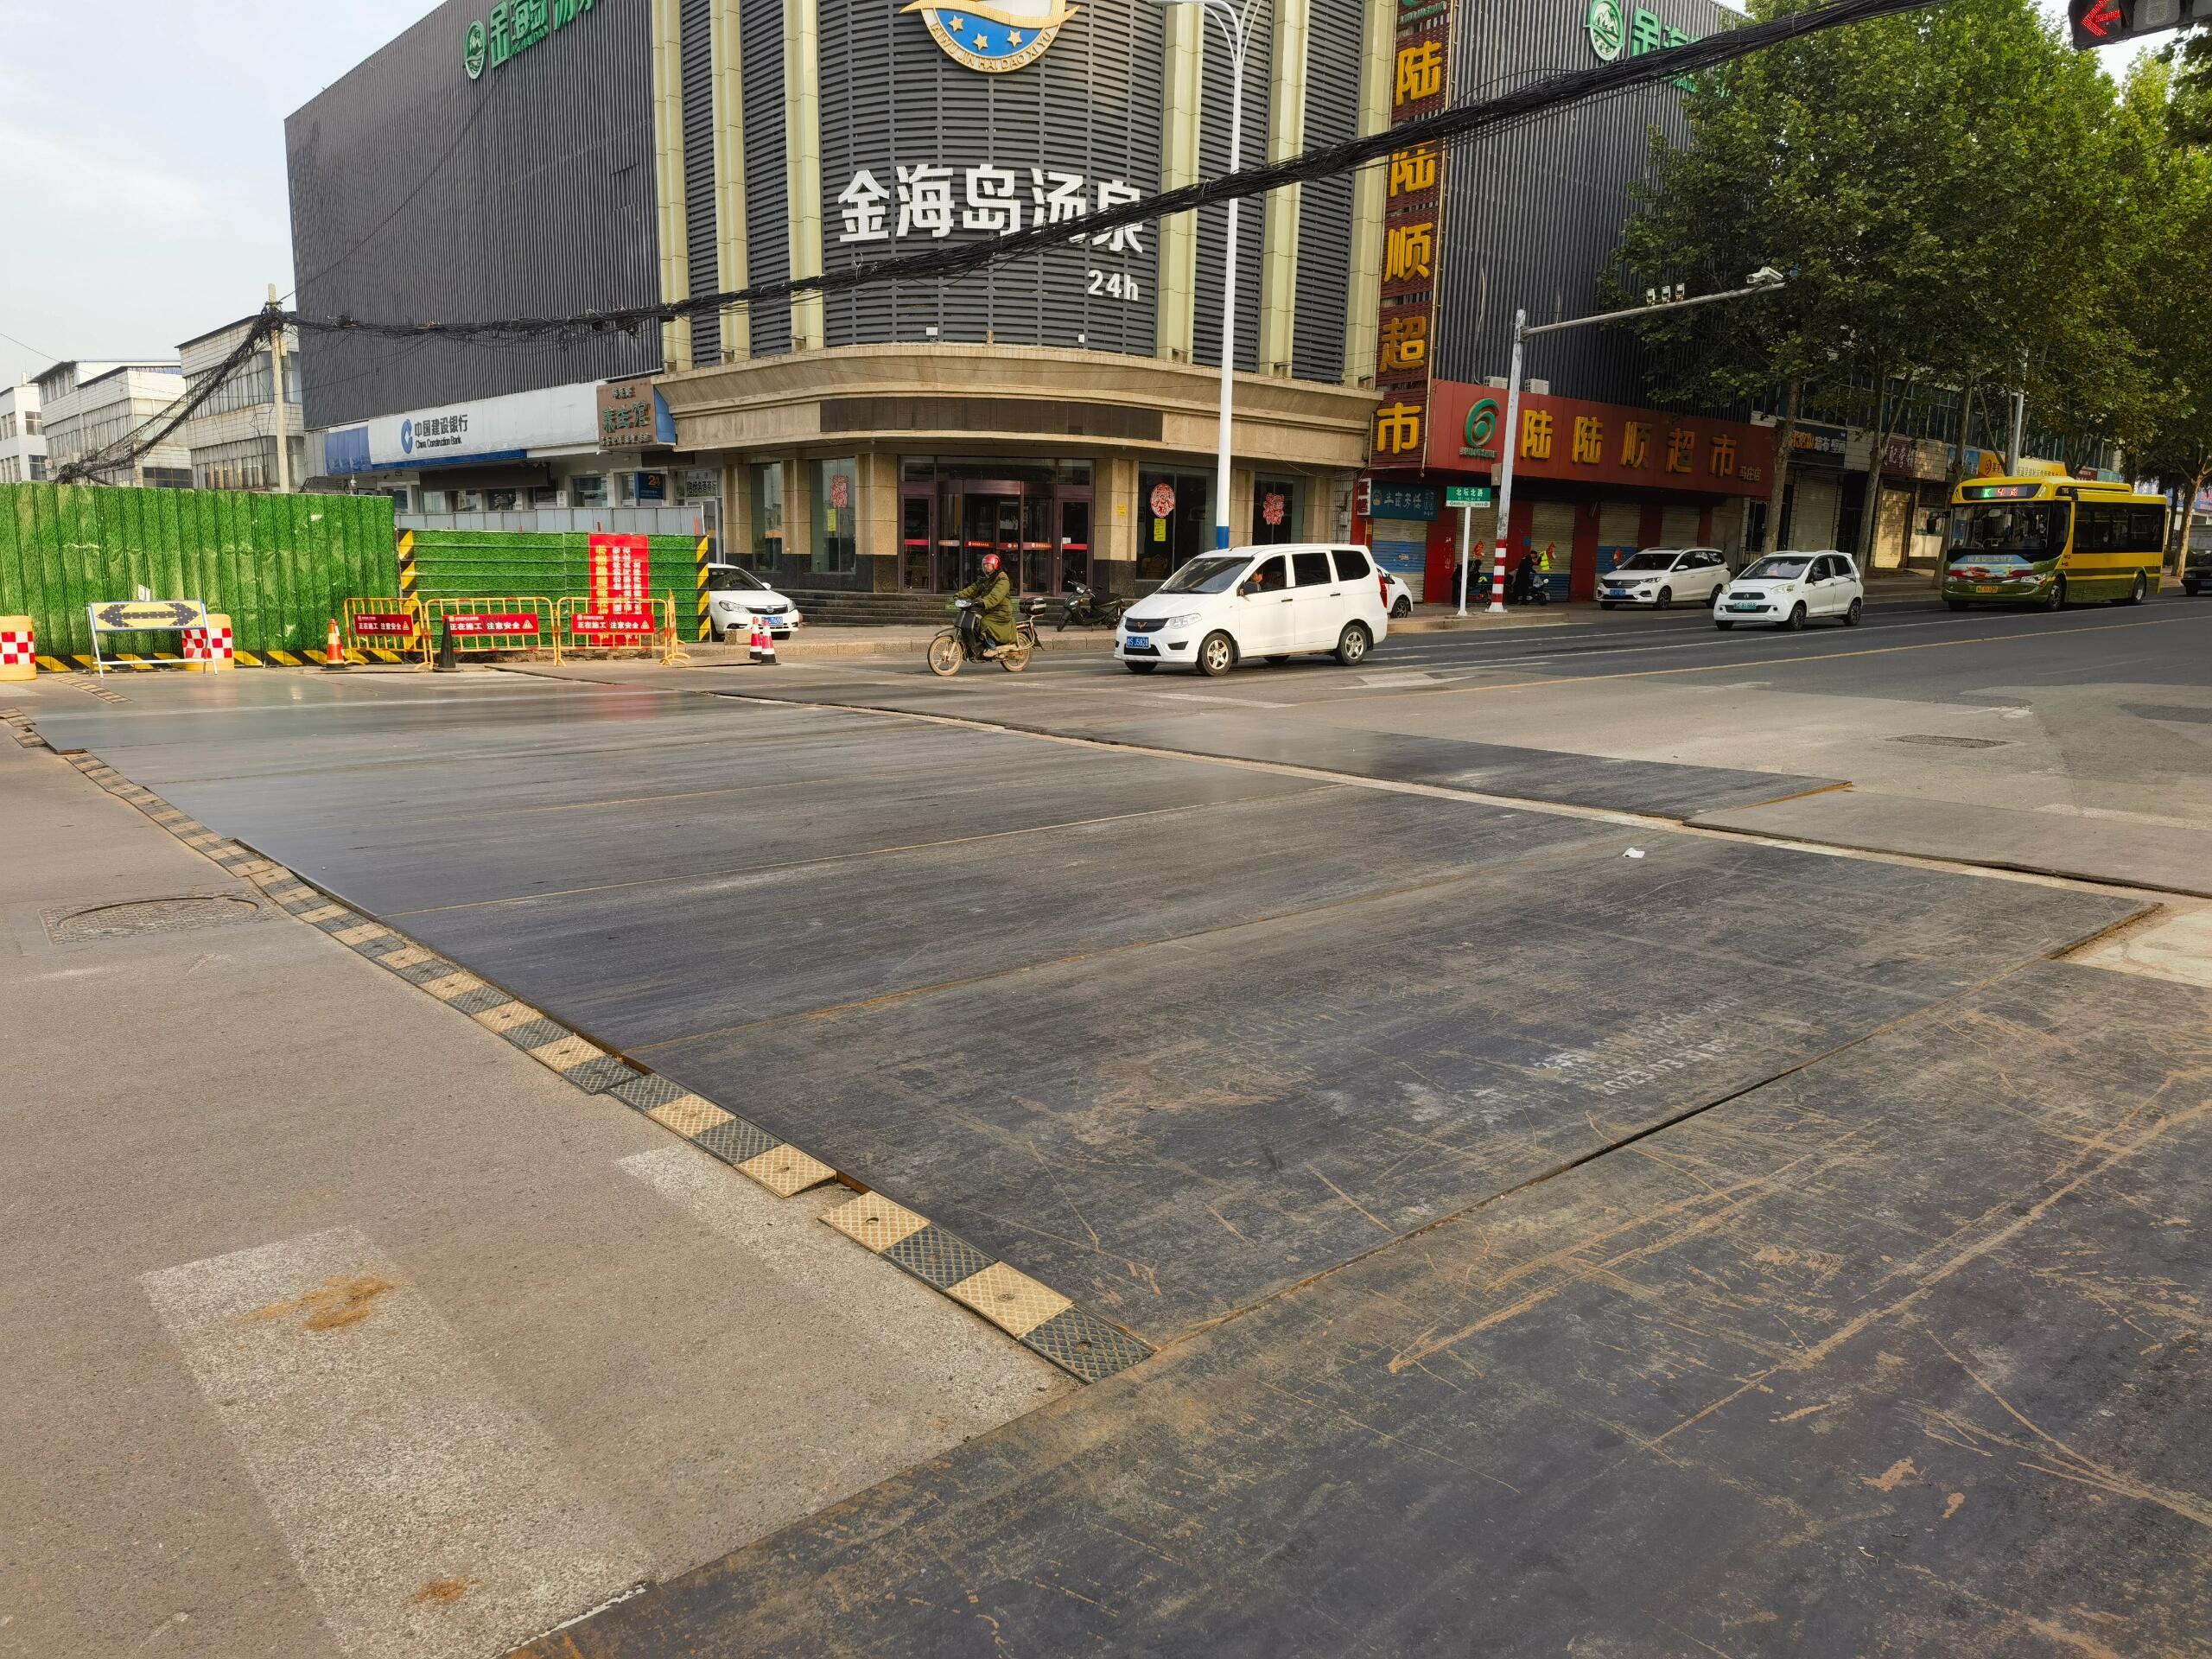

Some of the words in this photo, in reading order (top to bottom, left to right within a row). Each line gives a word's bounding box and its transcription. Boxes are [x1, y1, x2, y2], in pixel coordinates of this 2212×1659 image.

[957, 50, 976, 67] JIN
[978, 58, 999, 71] HAI
[1001, 54, 1026, 70] DAO
[1026, 48, 1040, 61] XI
[1037, 31, 1052, 48] YU
[837, 162, 1143, 255] 金海岛汤泉
[1376, 40, 1443, 454] 陆陆顺超市
[1087, 269, 1140, 302] 24h
[415, 415, 468, 437] 中国建设银行
[416, 440, 427, 449] China
[427, 437, 450, 448] Construction
[450, 435, 462, 446] Bank
[1520, 410, 1738, 476] 陆陆顺超市
